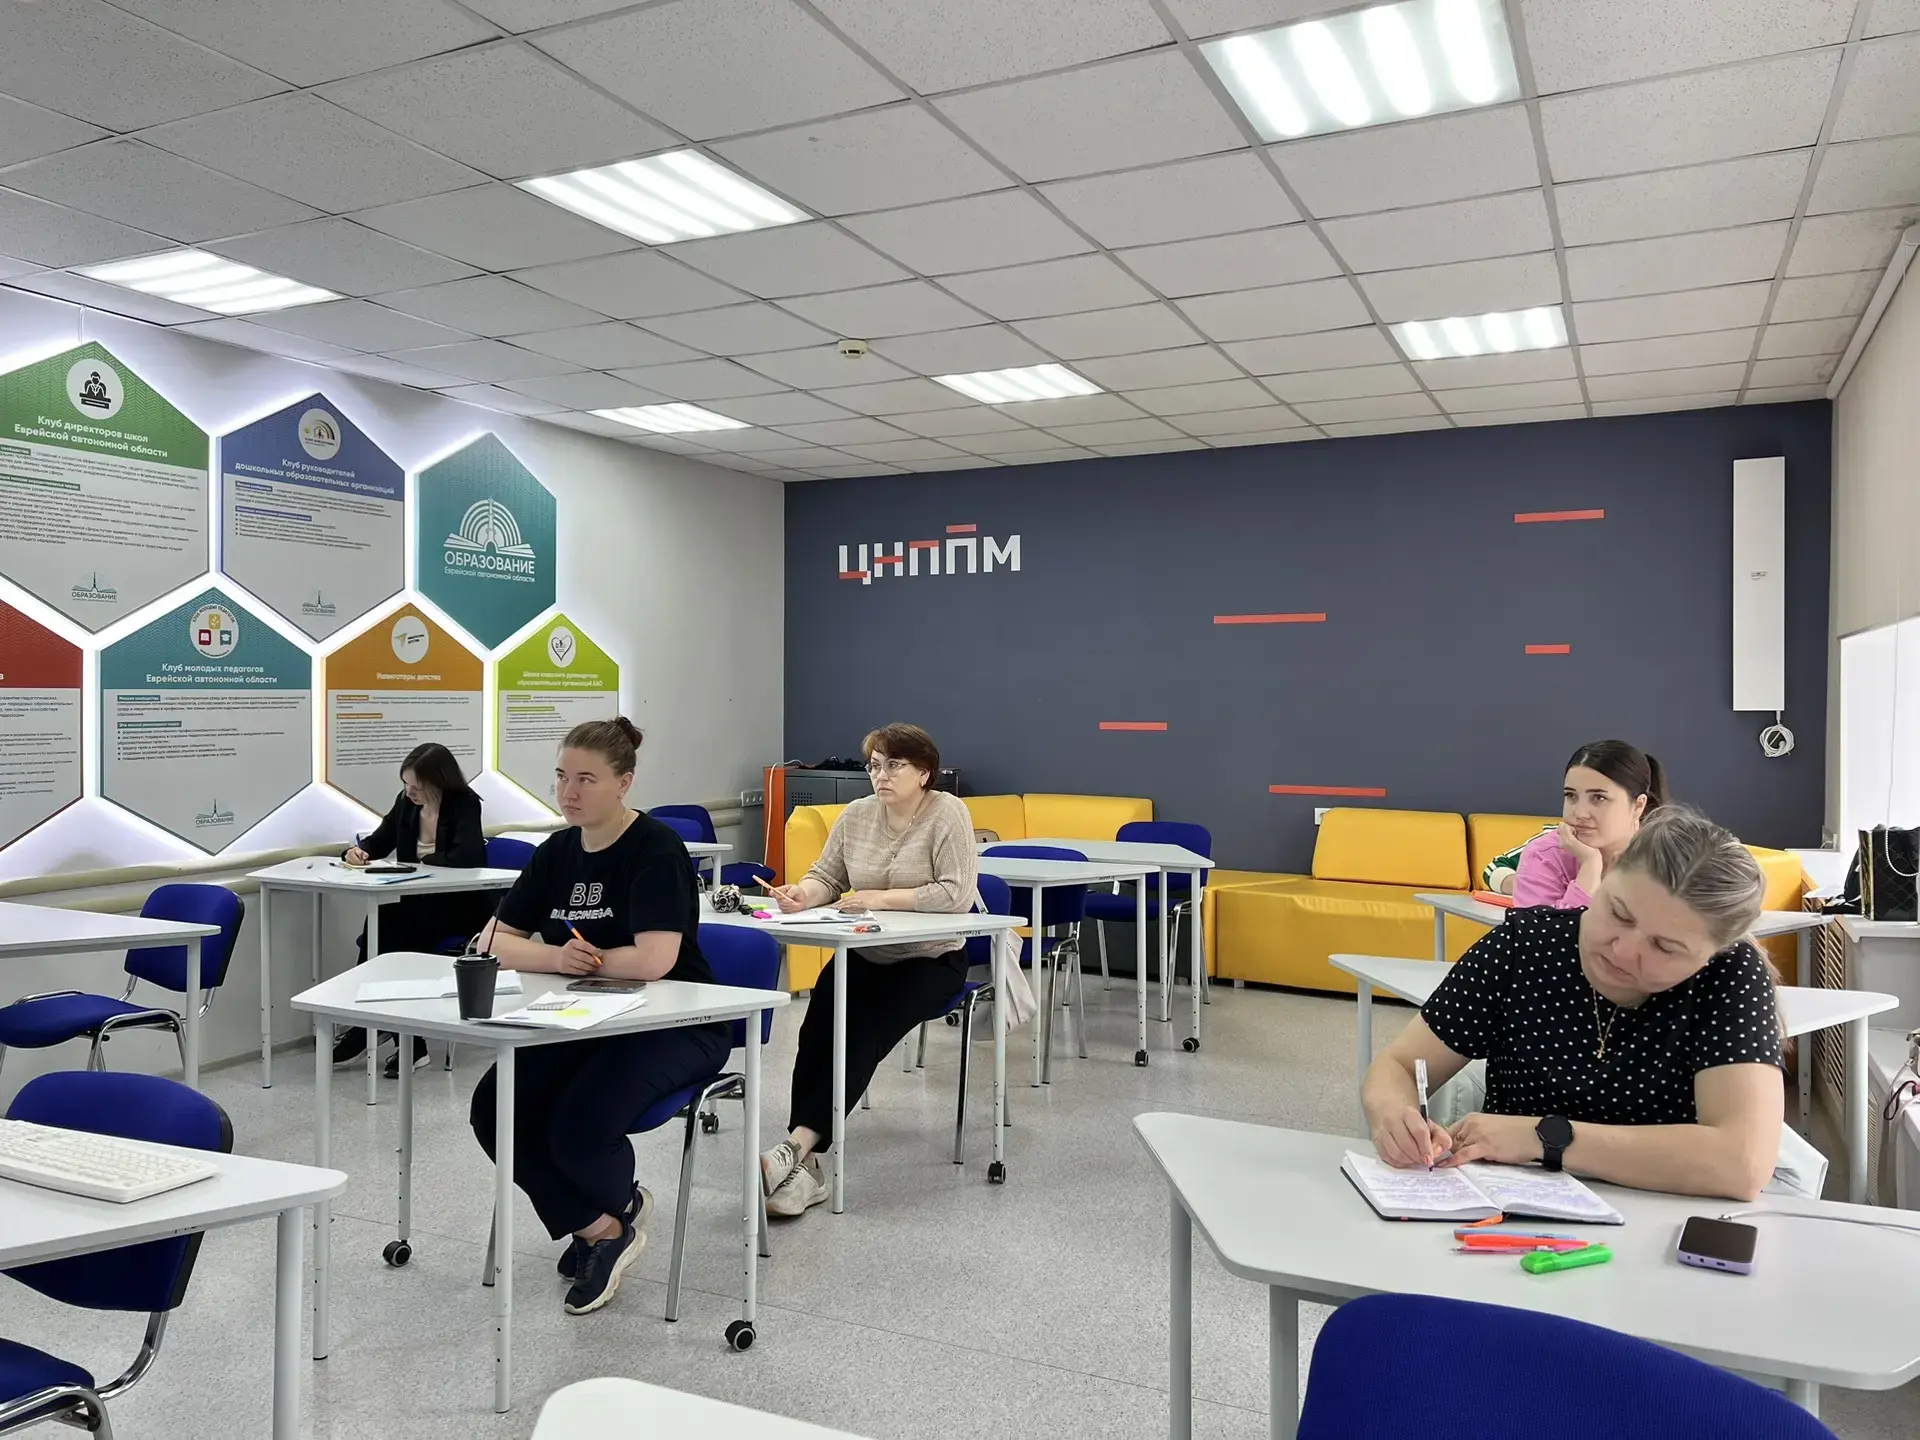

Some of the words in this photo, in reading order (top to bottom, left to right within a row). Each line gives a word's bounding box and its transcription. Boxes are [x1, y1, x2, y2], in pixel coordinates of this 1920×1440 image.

[14, 424, 69, 441] Еврейской
[71, 434, 129, 451] автономной
[130, 443, 168, 458] области
[37, 415, 62, 428] Клуб
[64, 422, 122, 439] директоров
[124, 432, 148, 443] школ
[235, 462, 284, 477] дошкольных
[285, 470, 350, 488] образовательных
[350, 481, 395, 495] организаций
[282, 458, 301, 470] Клуб
[301, 462, 356, 479] руководителей
[444, 550, 535, 575] ОБРАЗОВАНИЕ
[839, 524, 1021, 585] ЦНППМ
[444, 566, 476, 576] Еврейской
[477, 571, 511, 580] автономной
[512, 574, 535, 583] области
[71, 591, 117, 600] ОБРАЗОВАНИЕ
[146, 673, 192, 684] Еврейской
[194, 674, 244, 684] автономной
[245, 675, 278, 684] области
[162, 663, 183, 674] Клуб
[184, 664, 222, 674] молодых
[223, 665, 264, 675] педагогов
[569, 882, 604, 906] BB
